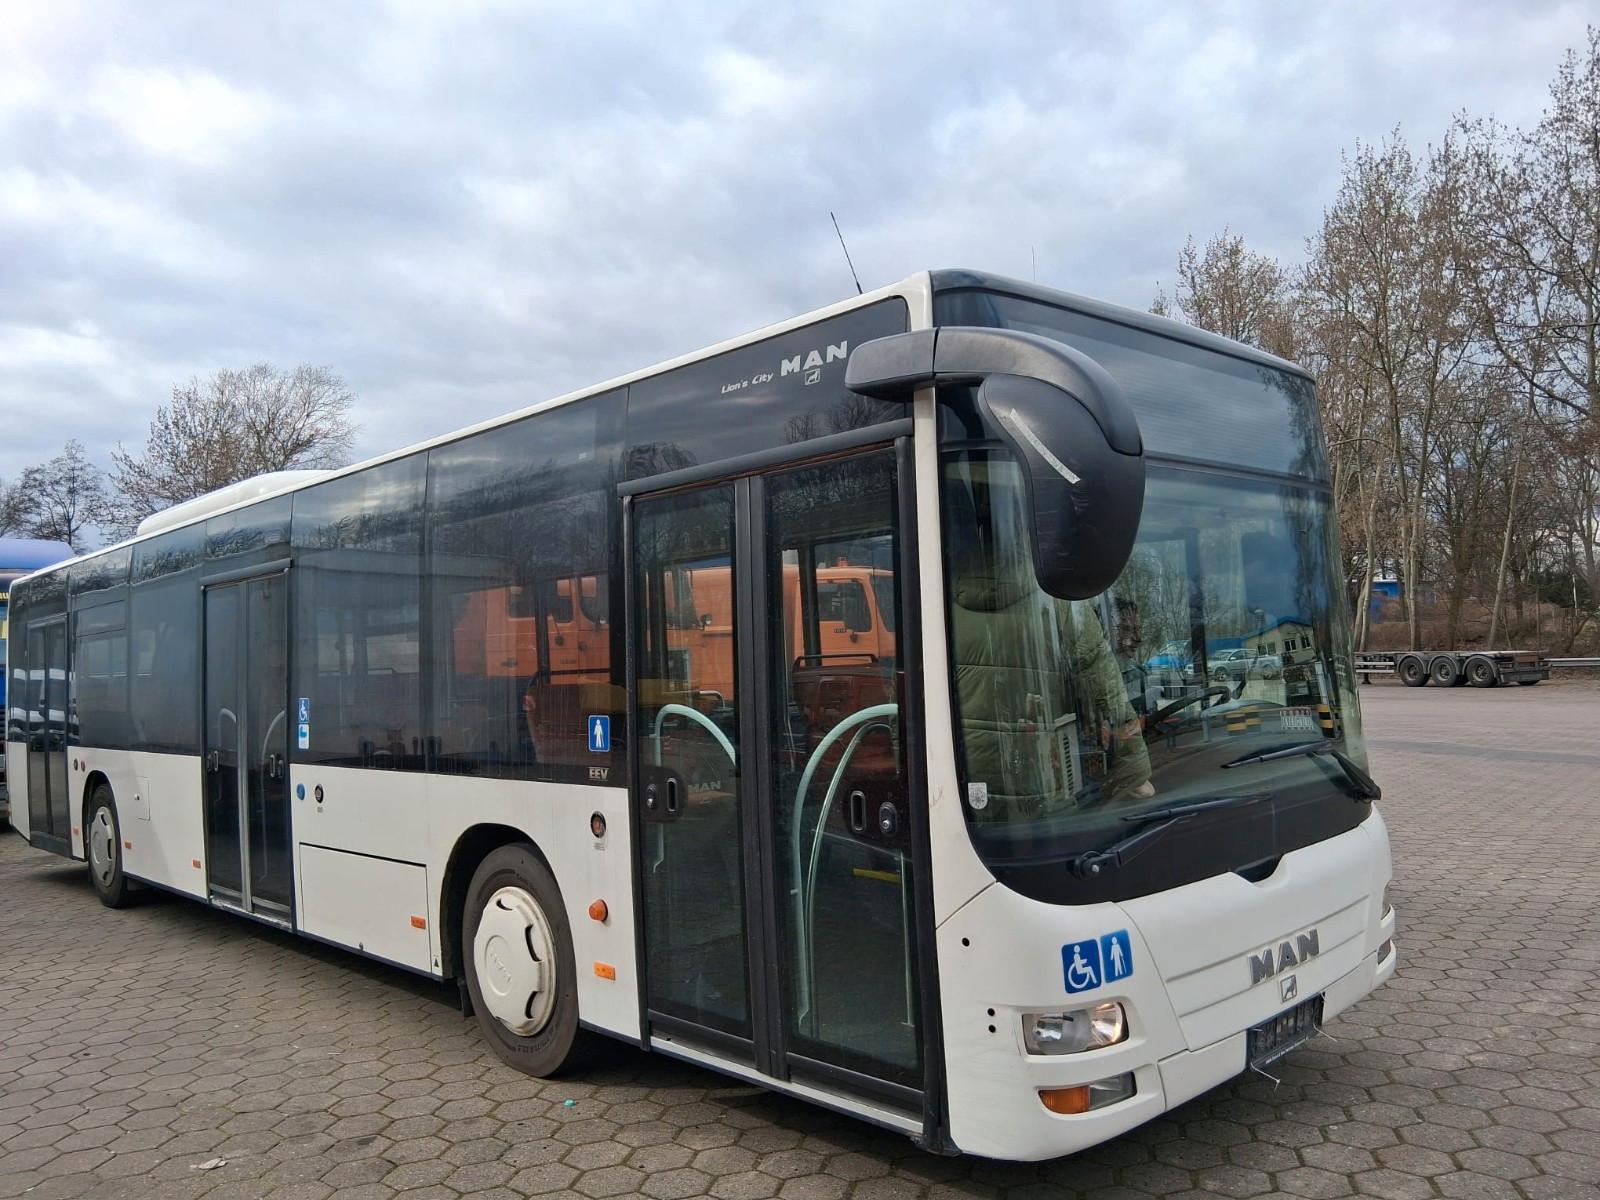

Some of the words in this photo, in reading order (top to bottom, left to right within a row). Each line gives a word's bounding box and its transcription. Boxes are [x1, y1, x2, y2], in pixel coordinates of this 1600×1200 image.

[780, 340, 848, 377] MAN
[721, 379, 748, 394] Lion's
[752, 371, 774, 385] City
[589, 767, 608, 780] EEV
[1248, 928, 1320, 985] MAN
